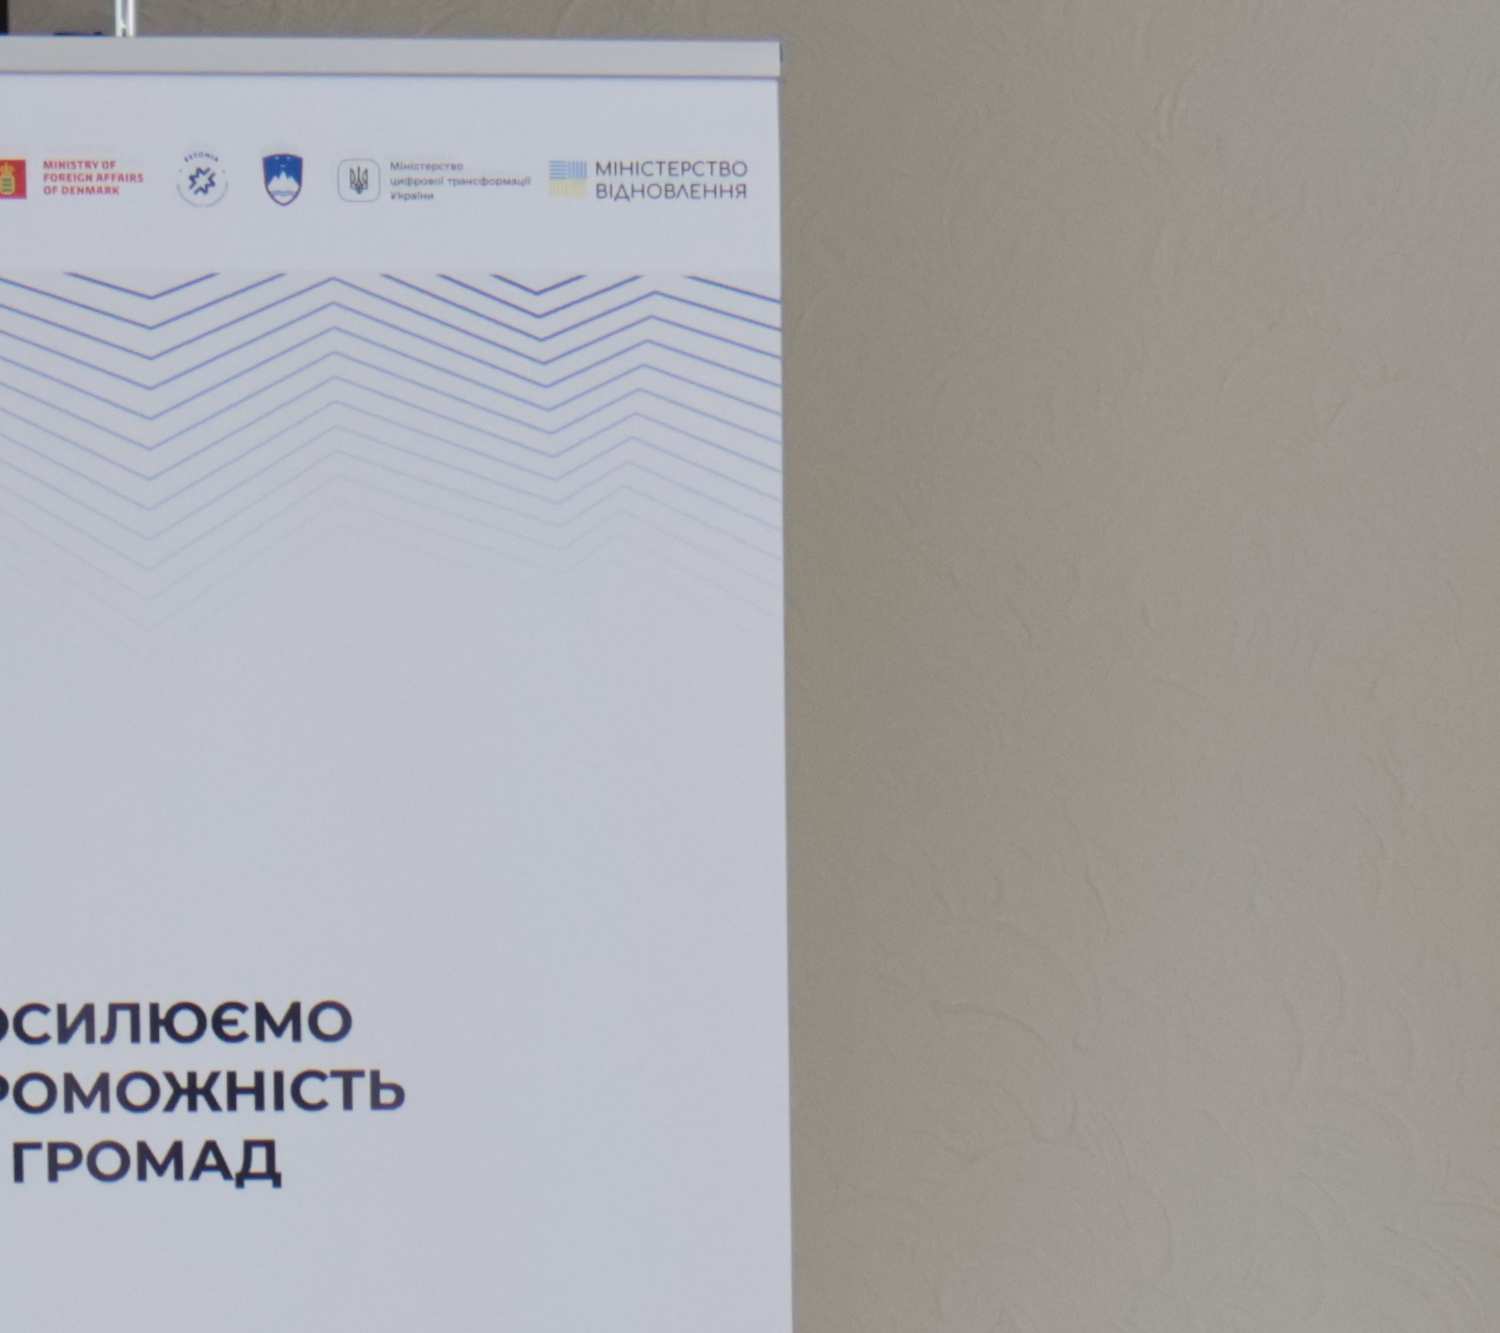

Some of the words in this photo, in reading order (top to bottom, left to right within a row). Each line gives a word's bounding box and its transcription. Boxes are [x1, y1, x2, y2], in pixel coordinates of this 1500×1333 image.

[43, 161, 98, 170] MINISTRY
[102, 161, 116, 170] OF
[390, 162, 463, 172] Міністерство
[595, 161, 747, 177] МІНІСТЕРСТВО
[43, 173, 92, 183] FOREIGN
[96, 173, 143, 183] AFFAIRS
[390, 176, 443, 188] цифрової
[447, 176, 531, 188] трансформації
[43, 186, 58, 195] OF
[62, 186, 119, 195] DENMARK
[390, 190, 434, 201] України
[595, 183, 747, 202] ВІДНОВЛЕННЯ
[12, 1138, 282, 1189] ГРОМАД
